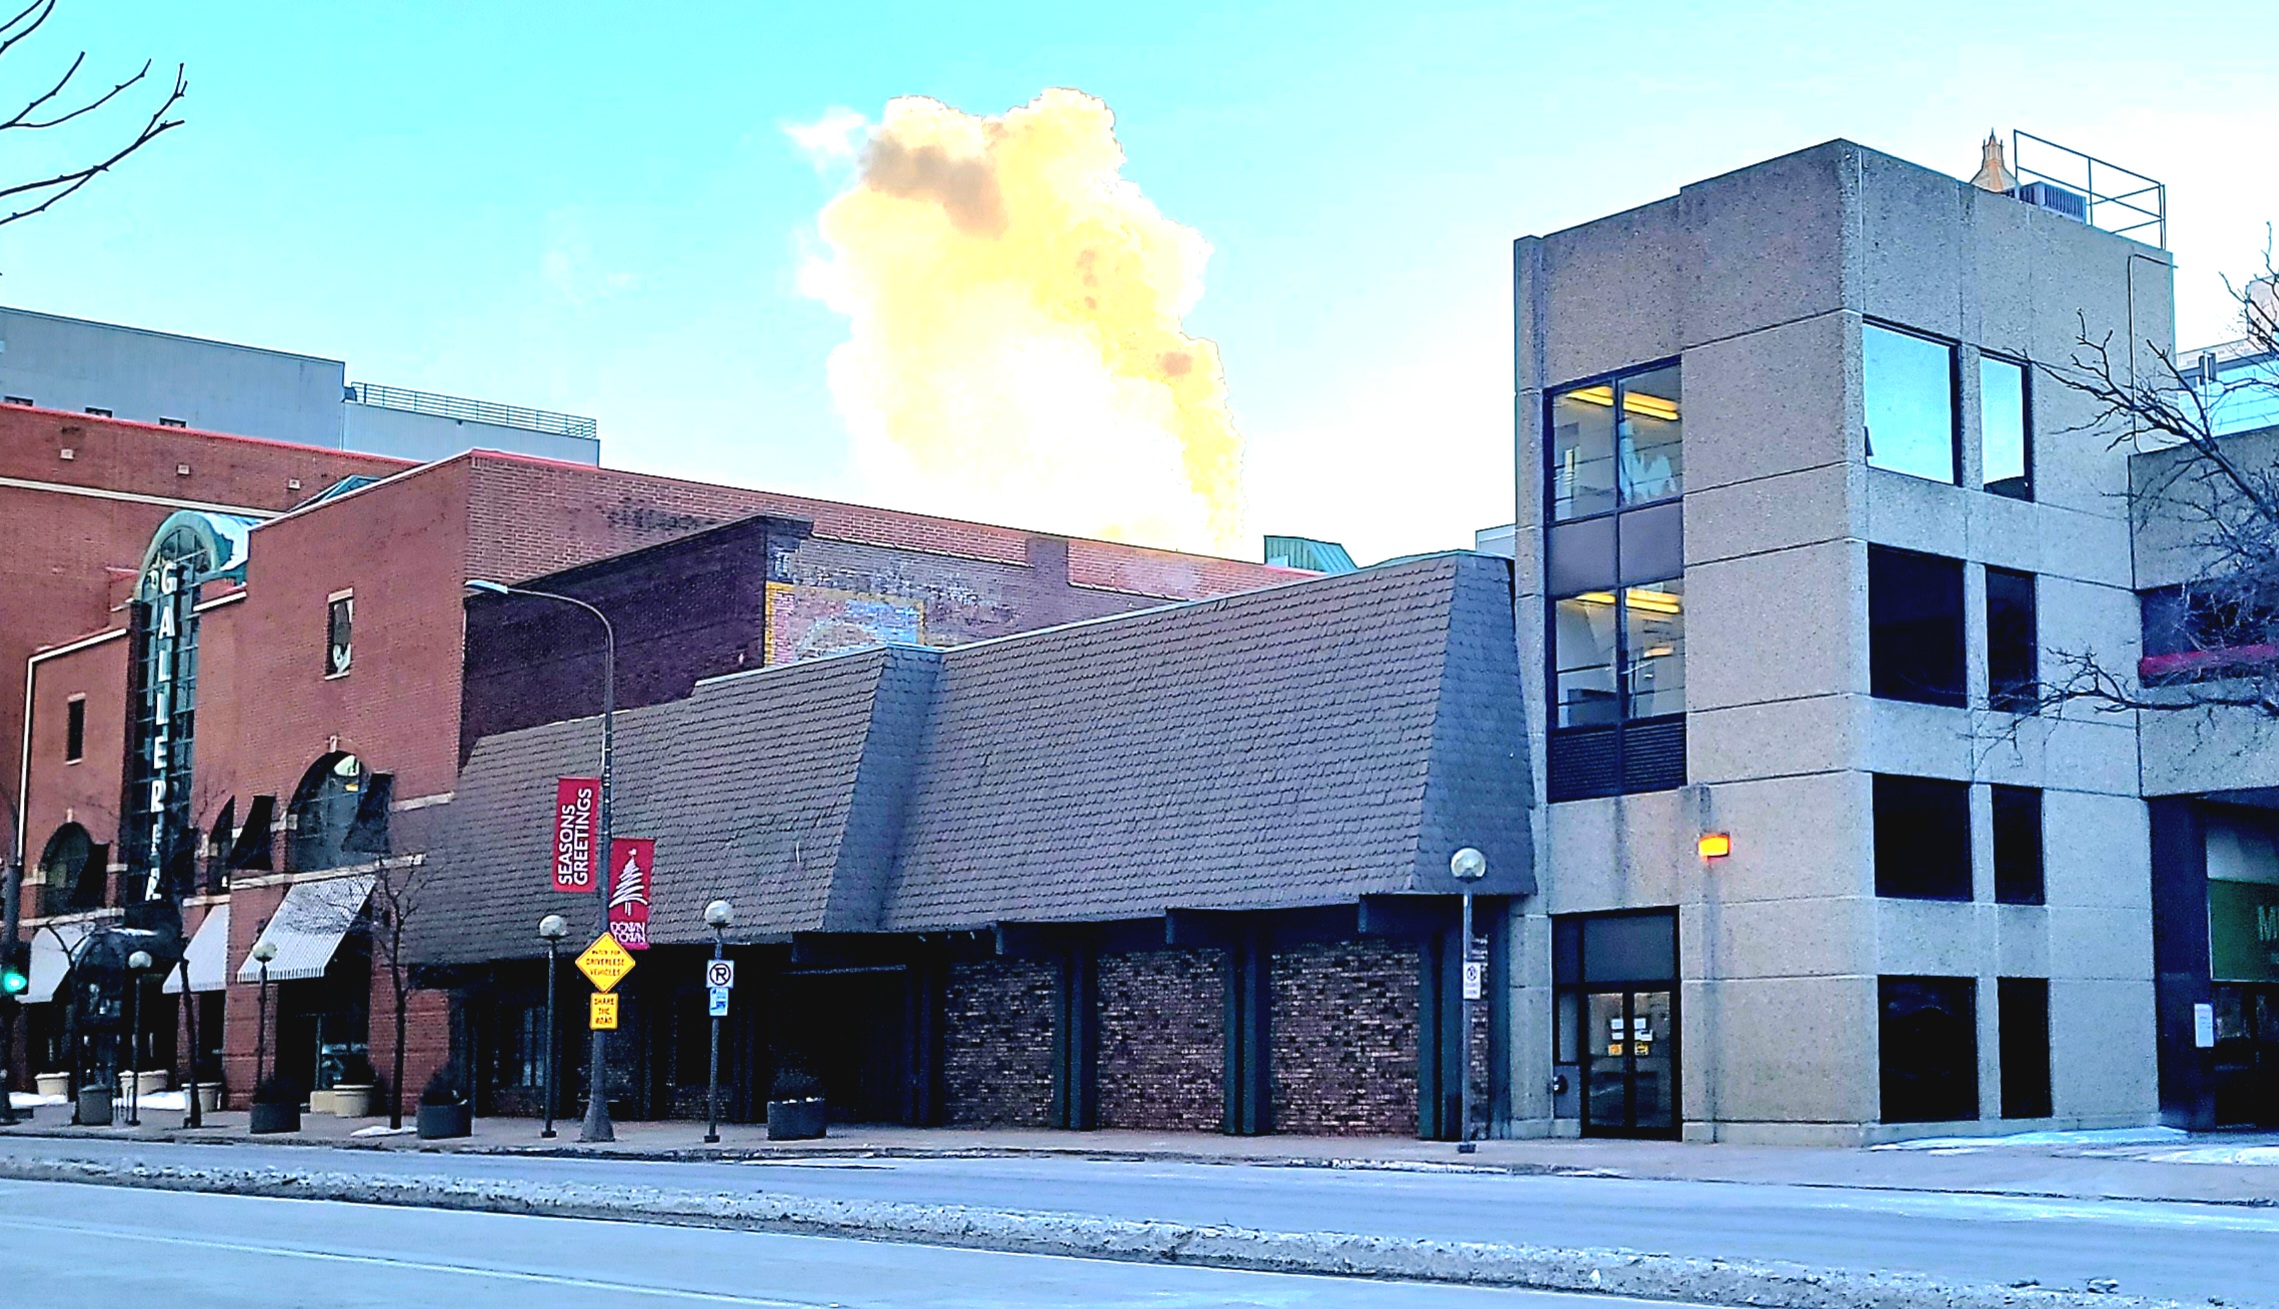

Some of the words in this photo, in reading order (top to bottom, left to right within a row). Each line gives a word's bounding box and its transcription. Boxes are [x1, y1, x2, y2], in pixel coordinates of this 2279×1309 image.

[573, 787, 593, 886] GREETINGS
[557, 804, 576, 886] SEASONS
[610, 921, 645, 933] DOWN
[590, 968, 621, 977] VEHICLES
[594, 997, 615, 1006] SHARE
